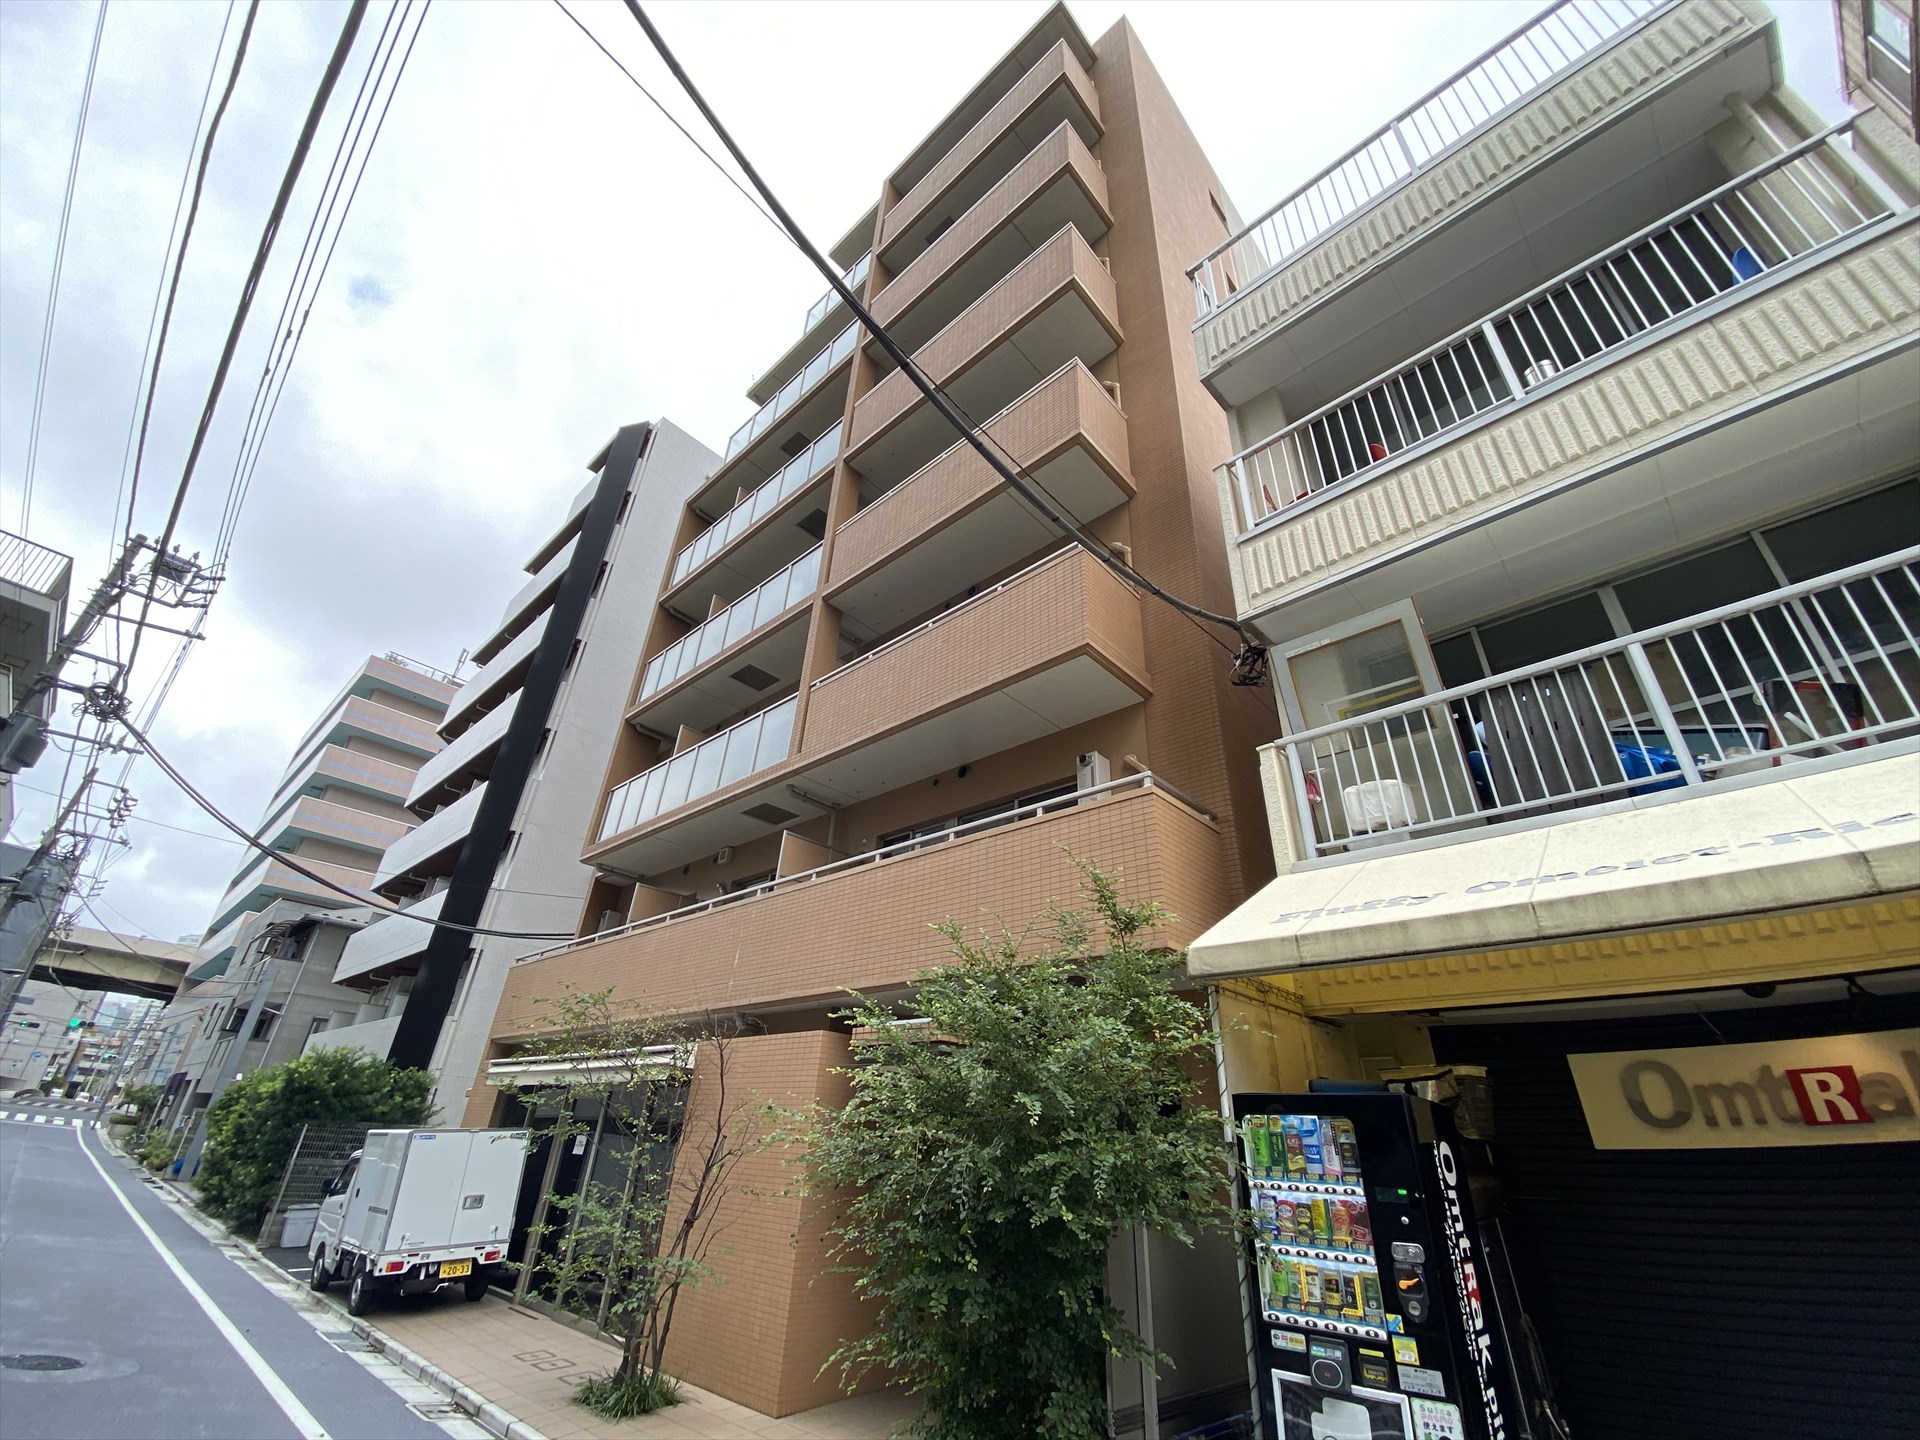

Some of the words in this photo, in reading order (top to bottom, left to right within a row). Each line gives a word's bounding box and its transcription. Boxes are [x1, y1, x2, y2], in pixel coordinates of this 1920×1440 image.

[1270, 892, 1447, 924] Fluffy
[1439, 1141, 1493, 1367] OmtRak
[1421, 1413, 1454, 1426] PASMO
[1423, 1421, 1455, 1435] 使えます
